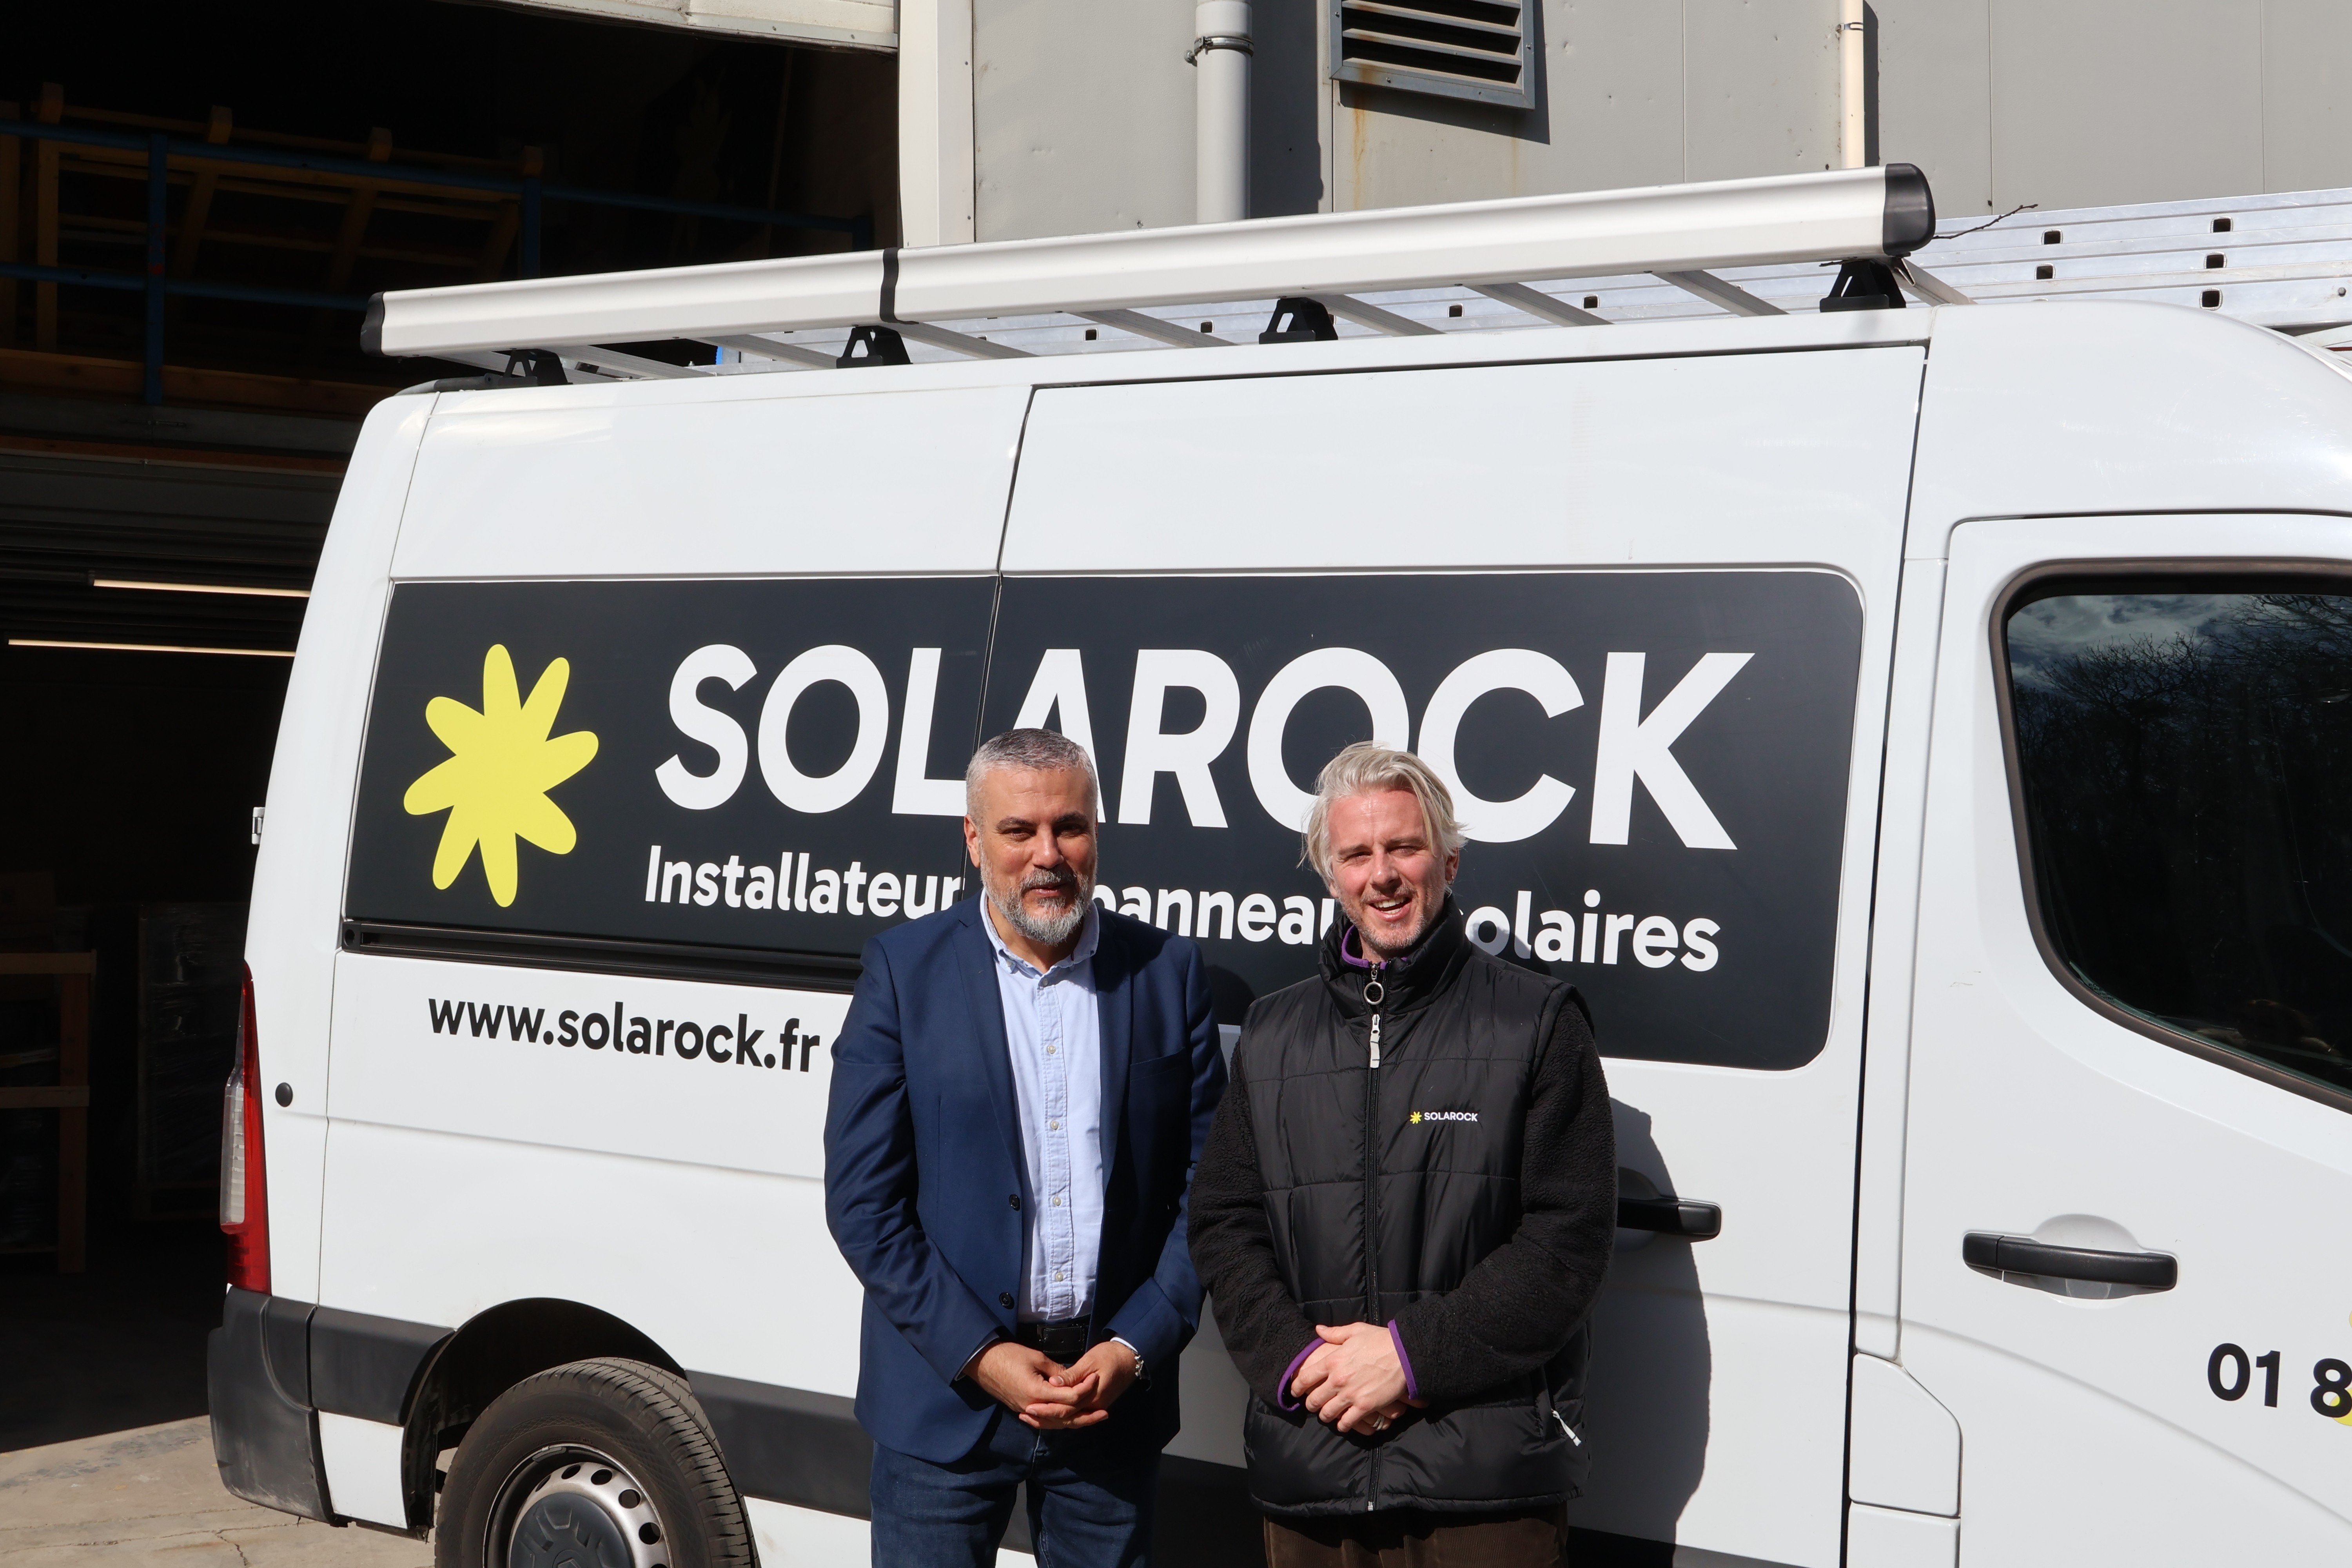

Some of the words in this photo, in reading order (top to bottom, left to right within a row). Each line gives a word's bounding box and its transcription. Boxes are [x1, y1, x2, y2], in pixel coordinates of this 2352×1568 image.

[655, 644, 1755, 850] SOLAROCK
[645, 845, 965, 920] Installateur
[1458, 889, 1720, 972] olaires
[428, 998, 820, 1072] www.solarock.fr
[1424, 1112, 1478, 1122] SOLAROCK
[2207, 1343, 2280, 1408] 01
[2310, 1358, 2352, 1417] 8
